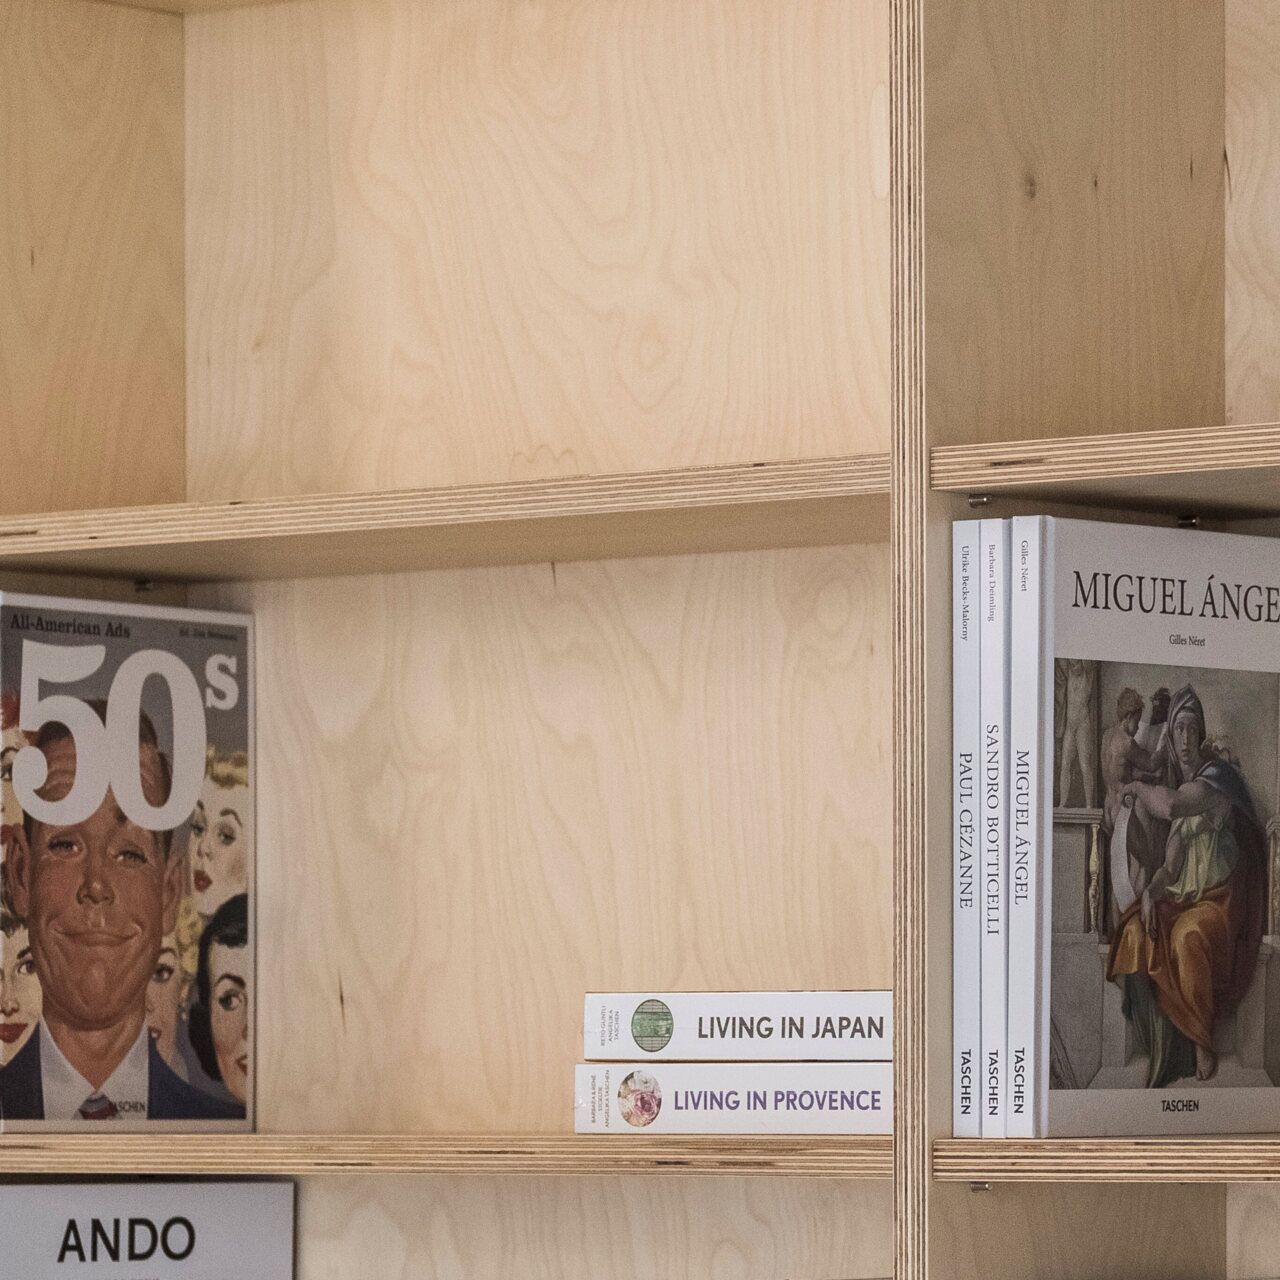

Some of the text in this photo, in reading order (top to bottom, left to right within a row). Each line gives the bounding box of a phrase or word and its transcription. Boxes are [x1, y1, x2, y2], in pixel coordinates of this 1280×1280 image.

[960, 545, 970, 641] Ulrike Becks-Malorny
[987, 544, 996, 622] Barbara Deimling
[1021, 540, 1030, 592] Gilles Néret
[1072, 570, 1194, 617] MIGUEL
[10, 614, 131, 639] All-American Ads
[1168, 633, 1206, 647] Gilles Néret
[12, 638, 240, 832] 50s
[959, 752, 975, 909] PAUL CÉZANNE
[986, 724, 999, 936] SANDRO BOTTICELLI
[1014, 750, 1031, 906] MIGUEL ÁNGEL
[698, 1016, 884, 1039] LIVING IN JAPAN
[674, 1090, 881, 1111] LIVING IN PROVENCE
[961, 1049, 972, 1115] TASCHEN
[989, 1049, 999, 1116] TASCHEN
[1014, 1047, 1025, 1114] TASCHEN
[1162, 1100, 1200, 1113] TASCHEN
[57, 1216, 196, 1263] ANDO
